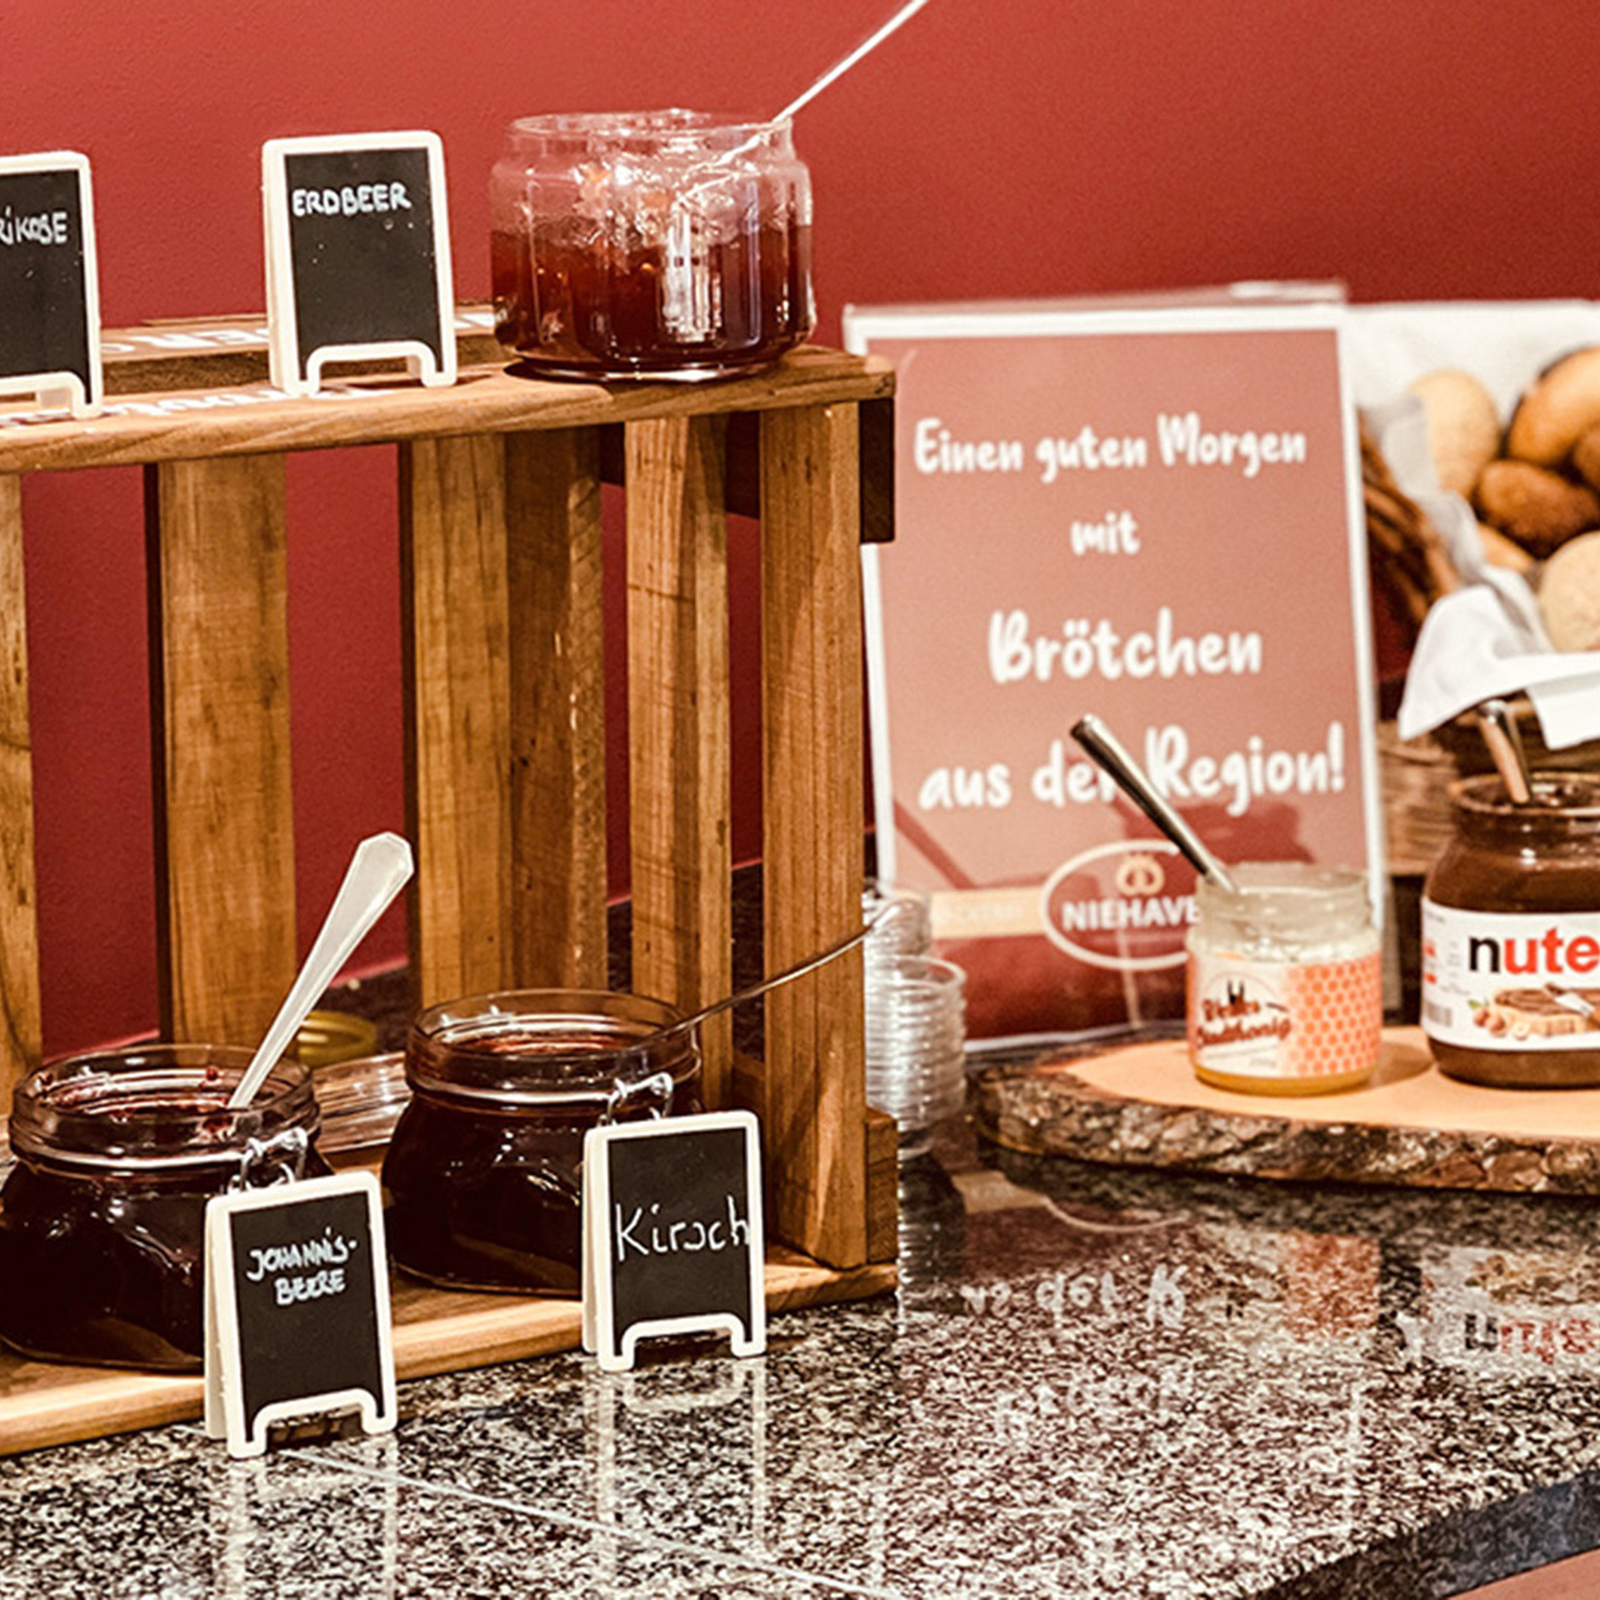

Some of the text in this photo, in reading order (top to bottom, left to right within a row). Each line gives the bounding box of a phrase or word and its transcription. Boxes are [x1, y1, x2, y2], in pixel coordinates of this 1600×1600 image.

[292, 181, 412, 217] ERDBEER
[914, 412, 1306, 483] Einen guten Morgen
[1070, 511, 1141, 555] mit
[988, 607, 1262, 683] Brötchen
[918, 763, 1011, 811] aus
[1145, 722, 1345, 817] Region!
[1469, 926, 1600, 975] nute
[615, 1195, 750, 1262] Kirsch
[274, 1268, 346, 1305] BEERE
